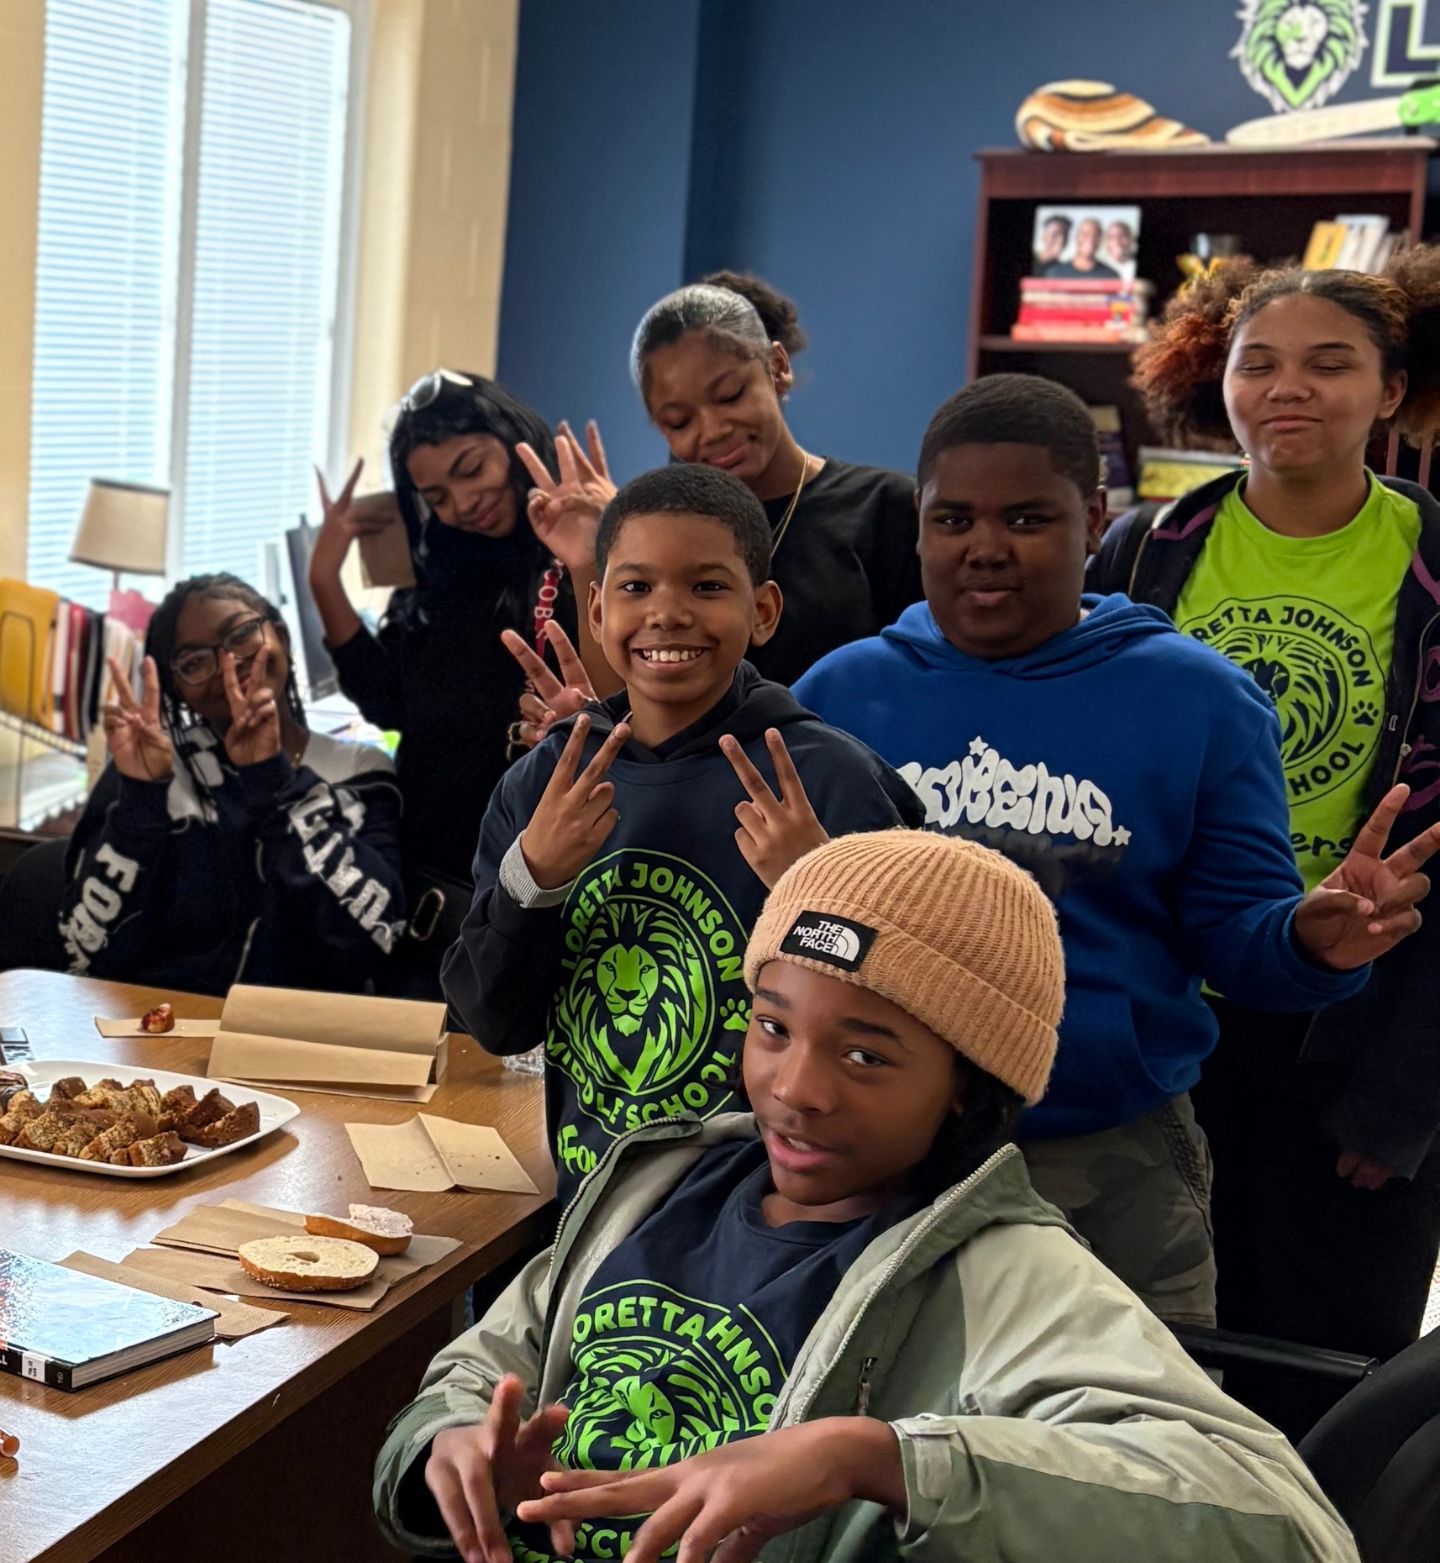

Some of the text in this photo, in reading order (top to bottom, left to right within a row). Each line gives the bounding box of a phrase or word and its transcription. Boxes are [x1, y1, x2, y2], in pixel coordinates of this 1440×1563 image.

[1189, 605, 1374, 688] RETTA JOHNSON
[1288, 740, 1366, 797] HOOL
[630, 862, 745, 982] JOHNSON
[793, 926, 839, 943] NORTH
[799, 936, 836, 954] FACE
[818, 920, 845, 935] THE
[572, 1296, 778, 1424] ORETTA HNSO
